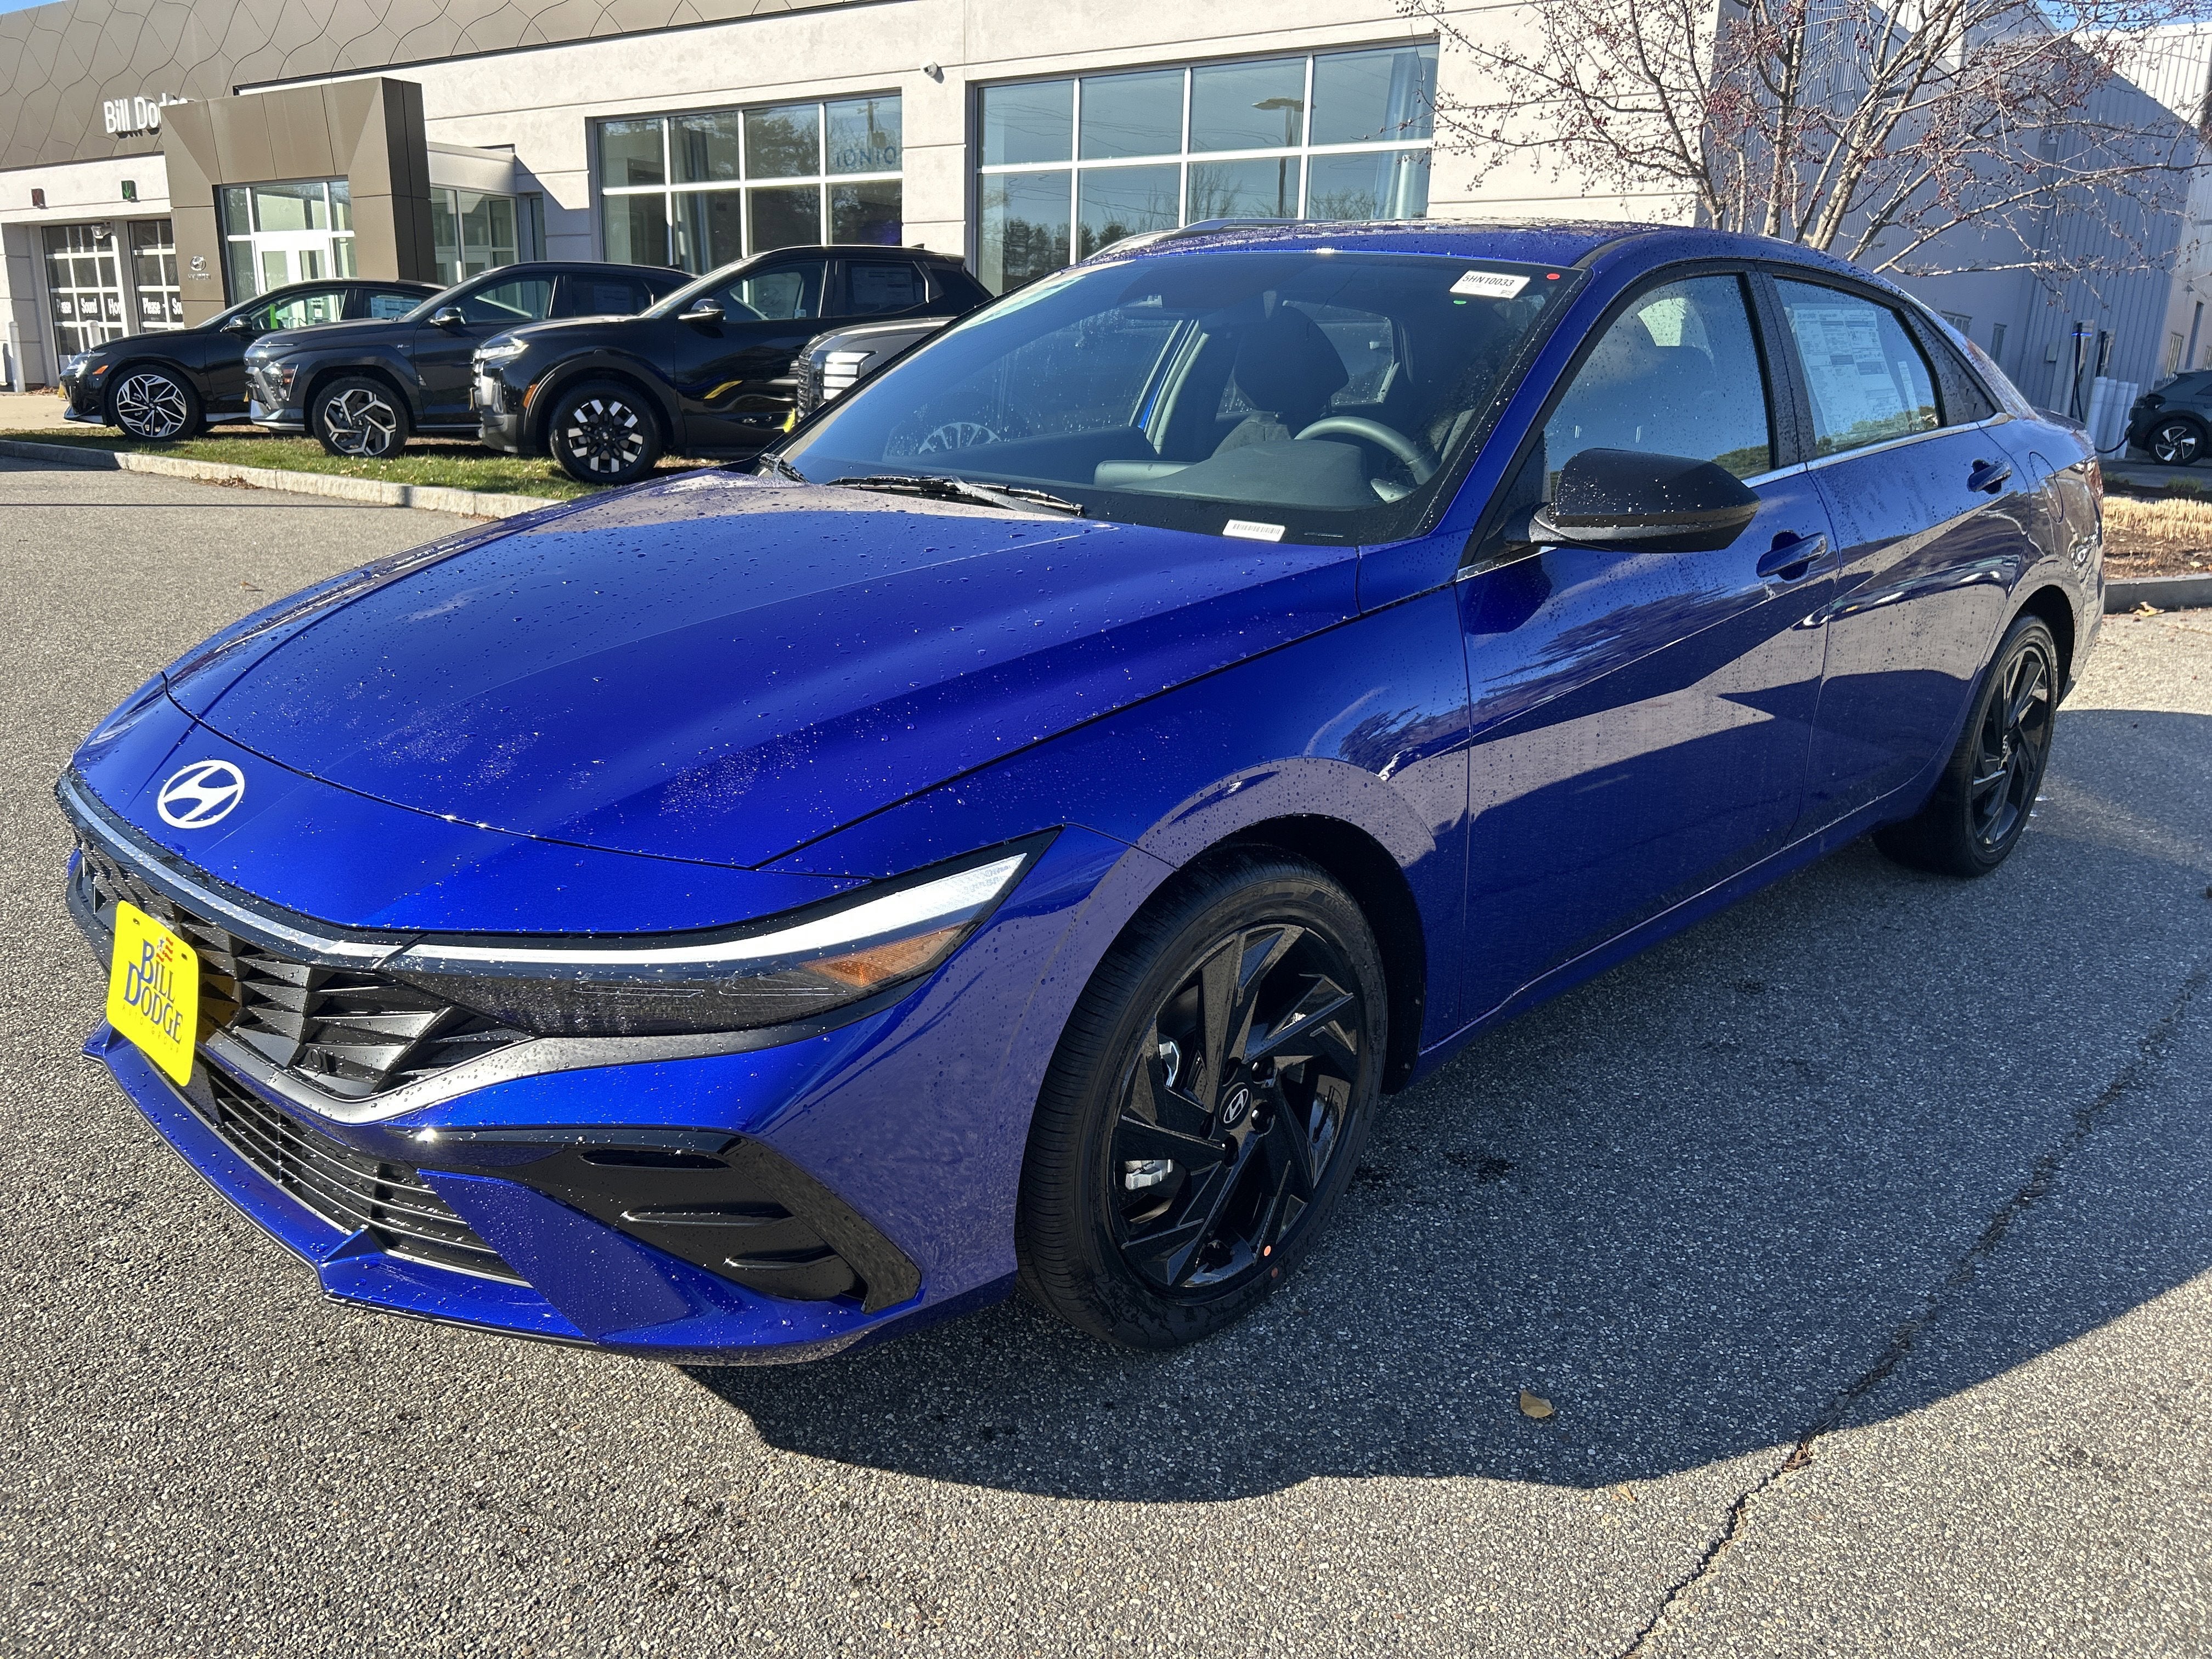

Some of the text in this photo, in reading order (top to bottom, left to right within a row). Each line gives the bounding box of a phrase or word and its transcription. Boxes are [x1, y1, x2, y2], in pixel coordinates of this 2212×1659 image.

[104, 99, 131, 133] Bill
[1463, 275, 1515, 286] 5HN10033
[140, 938, 176, 1004] BILL
[123, 961, 183, 1045] DODGE
[122, 1005, 179, 1053] AUTO GROUP
